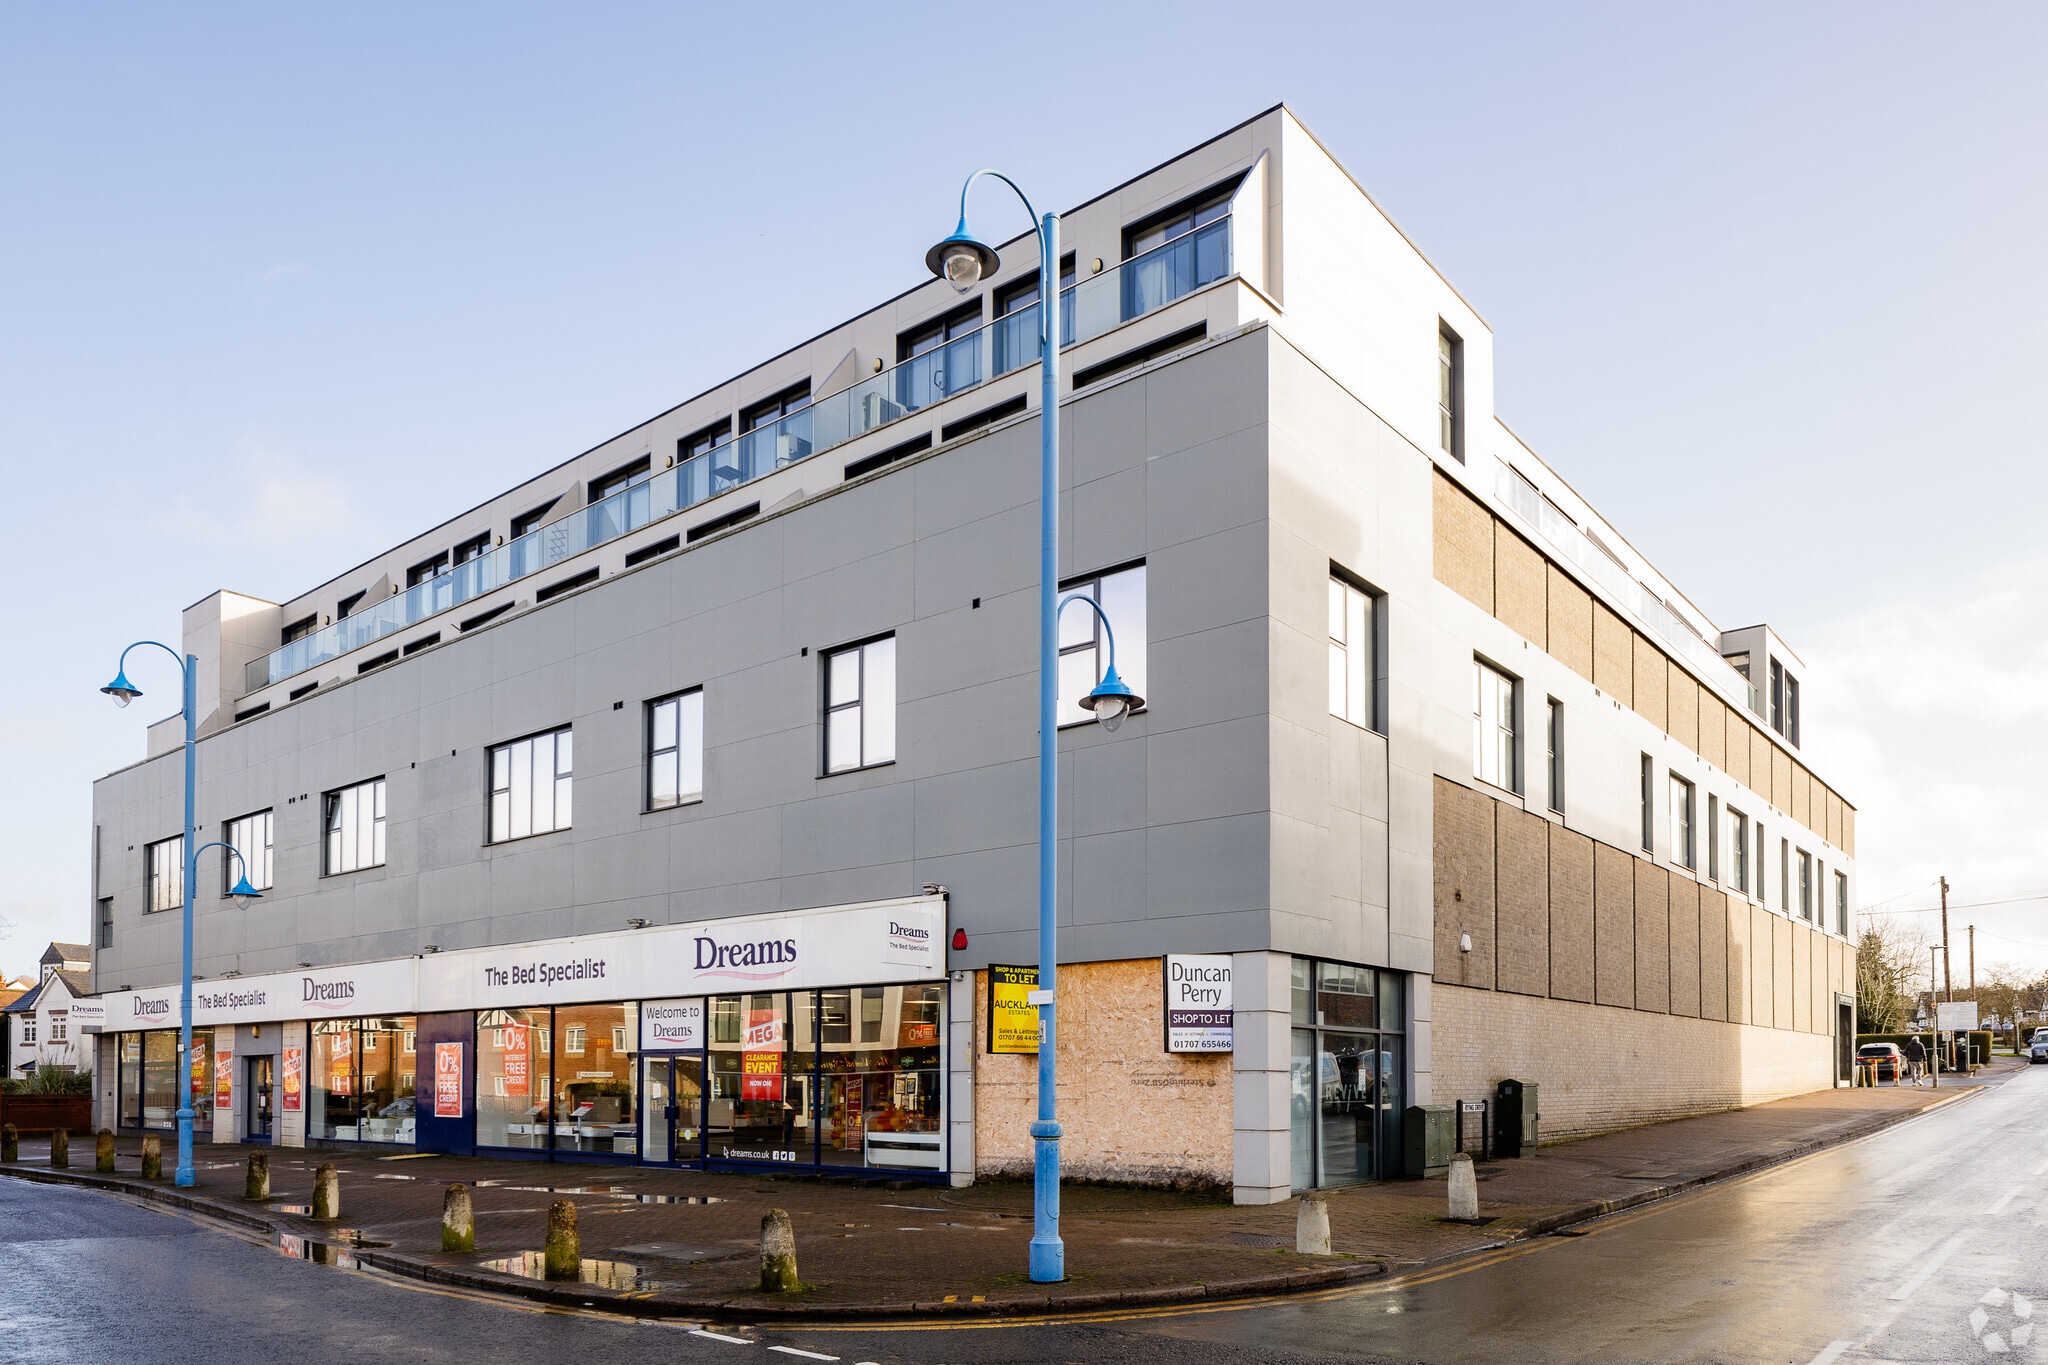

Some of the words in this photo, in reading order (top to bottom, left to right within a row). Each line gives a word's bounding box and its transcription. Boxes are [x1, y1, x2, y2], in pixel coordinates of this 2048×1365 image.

[889, 921, 929, 939] Dreams
[693, 936, 797, 970] Dreams
[908, 944, 930, 952] Specialist
[485, 966, 508, 986] The
[512, 963, 535, 984] Bed
[539, 958, 606, 987] Specialist
[1172, 962, 1231, 982] Duncan
[1004, 974, 1017, 983] TO
[1019, 975, 1035, 984] LET
[302, 977, 355, 1002] Dreams
[1181, 983, 1222, 1007] Perry
[133, 996, 169, 1016] Dreams
[198, 995, 212, 1009] The
[213, 993, 228, 1008] Bed
[229, 990, 266, 1011] Specialist
[994, 1000, 1038, 1010] AUCKLAN
[71, 1004, 104, 1013] Dreams
[646, 1006, 687, 1019] Welcome
[690, 1006, 700, 1017] to
[1173, 1013, 1198, 1024] SHOP
[1199, 1014, 1213, 1024] TO
[1215, 1014, 1231, 1024] LET
[653, 1023, 692, 1038] Dreams
[742, 1024, 783, 1047] MEGA
[505, 1027, 526, 1051] 0%
[1174, 1040, 1199, 1048] 01707
[1201, 1040, 1232, 1049] 655466
[439, 1050, 459, 1073] 0%
[745, 1053, 779, 1062] CLEARANCE
[504, 1062, 526, 1075] FREE
[745, 1061, 779, 1074] EVENT
[505, 1075, 526, 1085] CREDIT
[439, 1081, 458, 1093] FREE
[439, 1094, 458, 1102] CREDIT
[730, 1148, 770, 1159] dreams.co.uk
